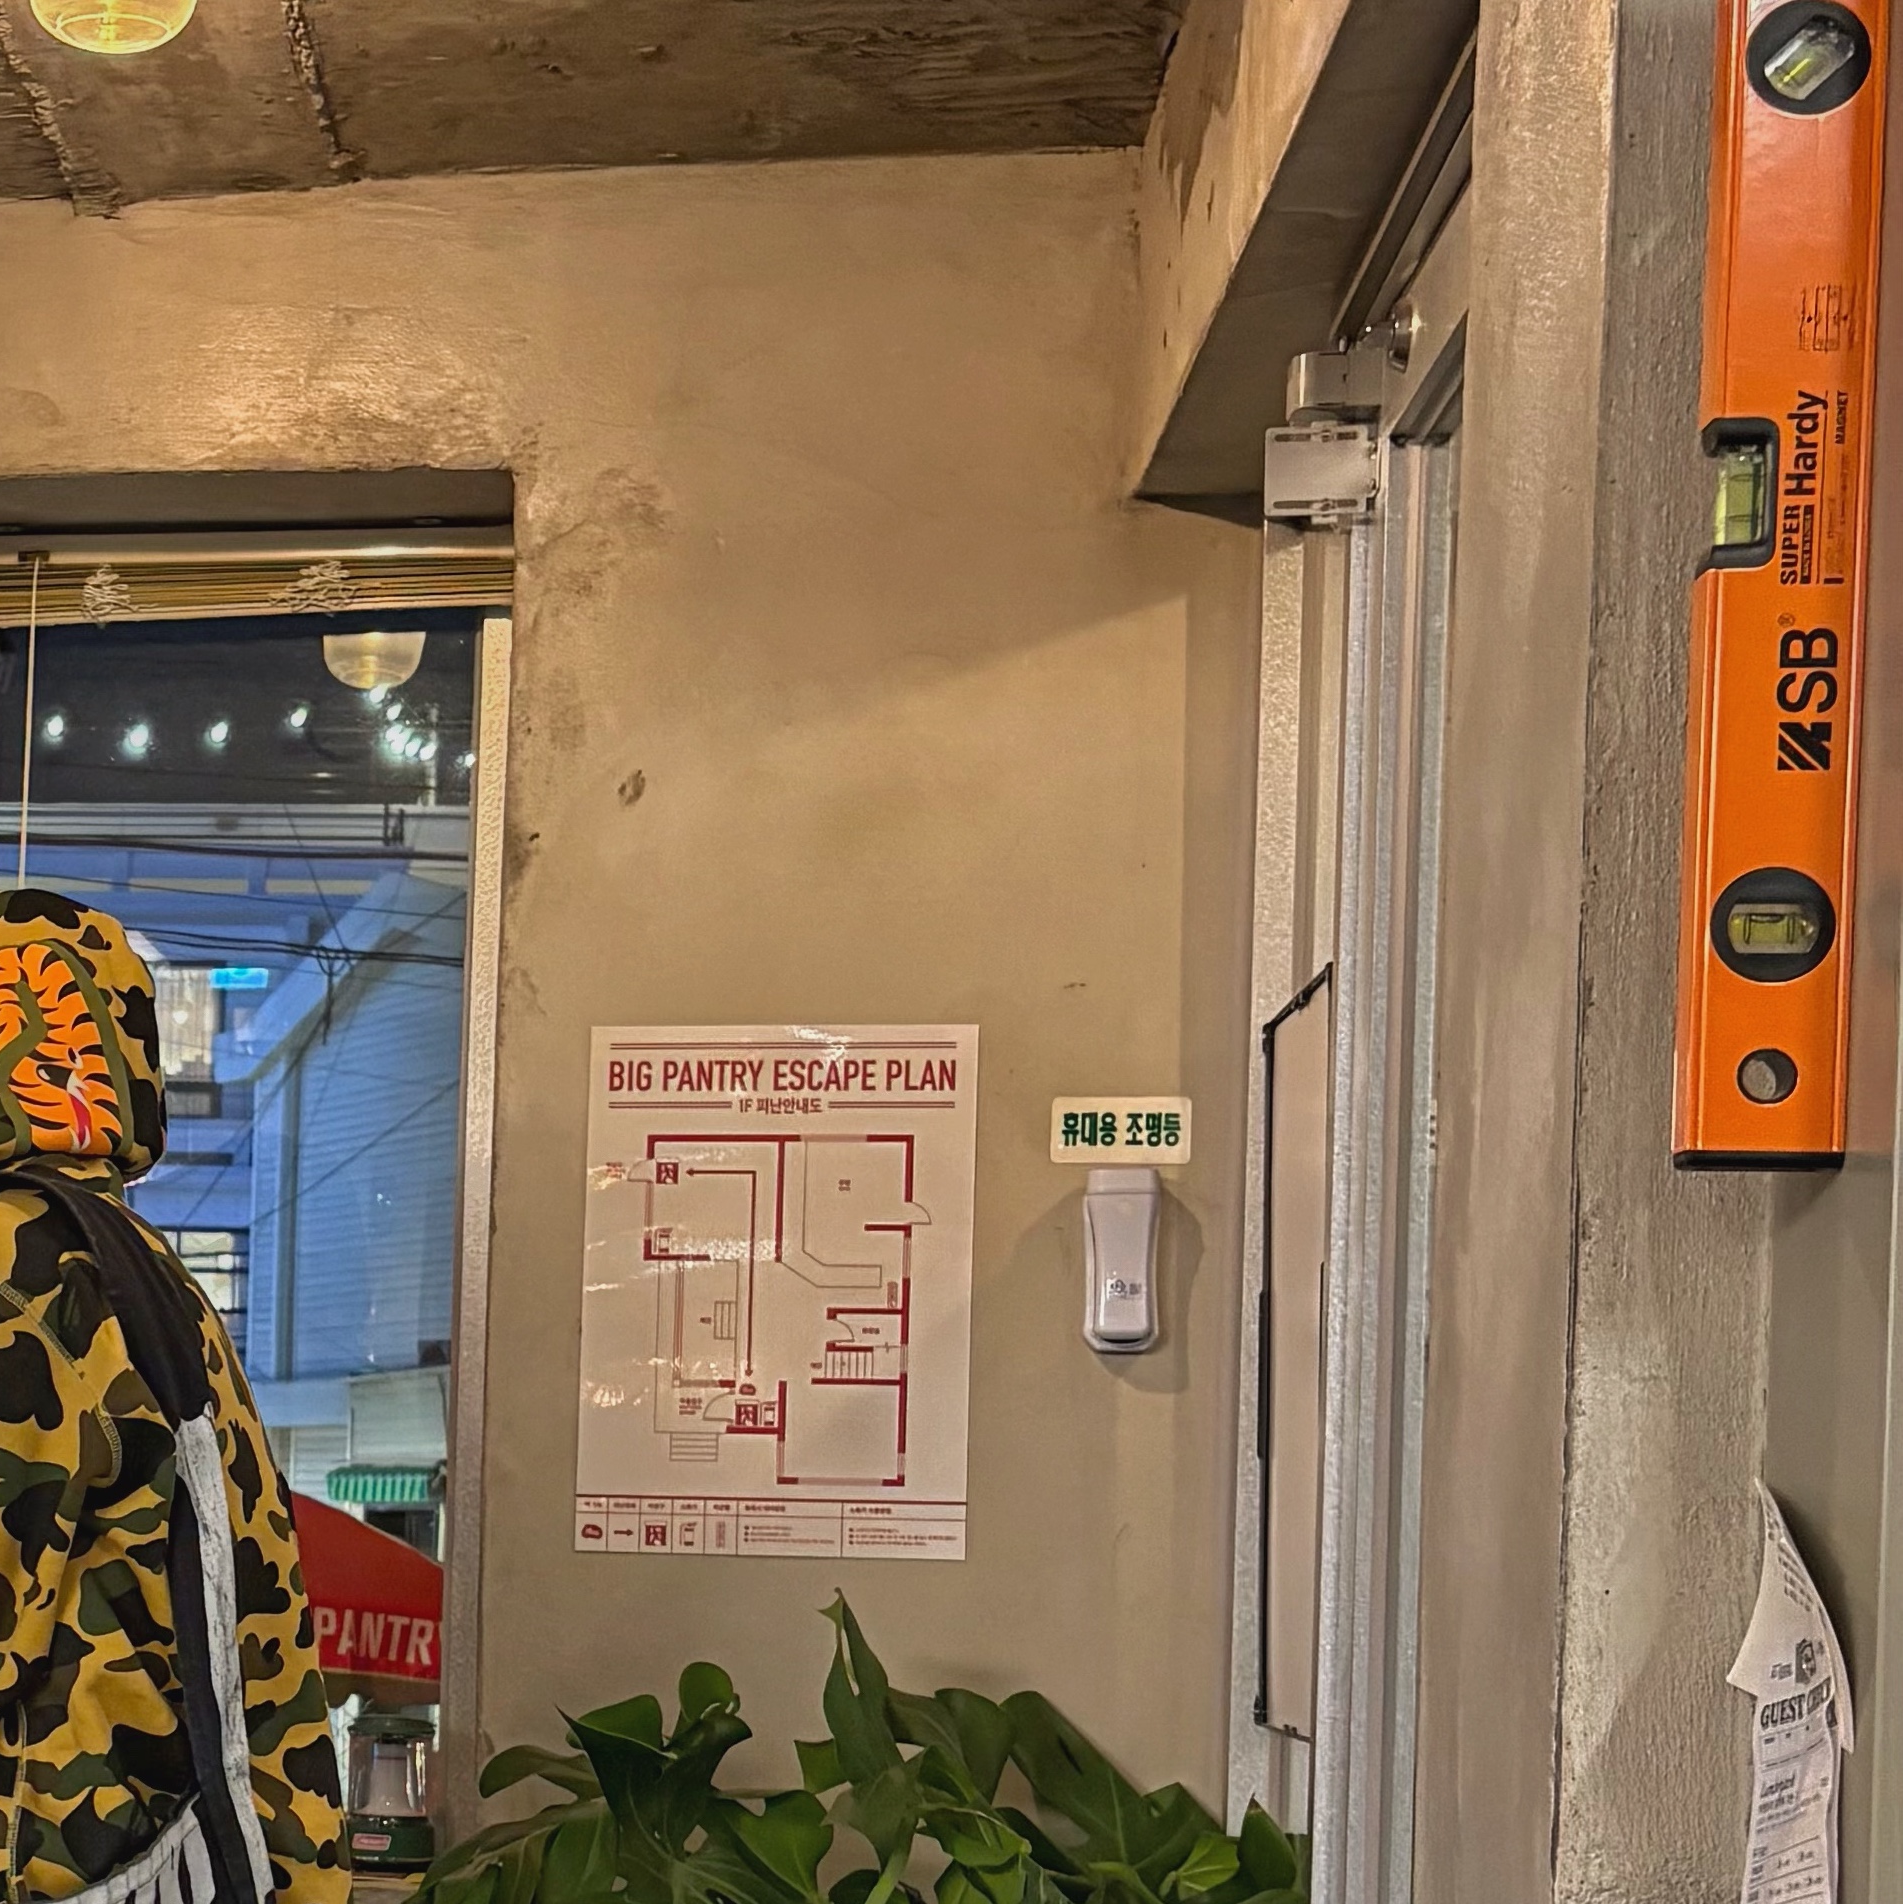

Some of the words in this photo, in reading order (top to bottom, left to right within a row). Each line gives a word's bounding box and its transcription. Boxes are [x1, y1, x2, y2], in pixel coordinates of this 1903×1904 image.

[1784, 390, 1829, 496] Hardy
[1780, 504, 1801, 585] SUPER
[1776, 626, 1839, 714] SB
[608, 1060, 653, 1092] BIG
[662, 1060, 764, 1092] PANTRY
[773, 1060, 876, 1092] ESCAPE
[885, 1060, 956, 1092] PLAN
[756, 1097, 823, 1115] 피난안내도
[1062, 1112, 1118, 1147] 휴대용
[1125, 1112, 1181, 1147] 조명등
[314, 1606, 442, 1667] PANTR
[1760, 1694, 1806, 1732] GUEST
